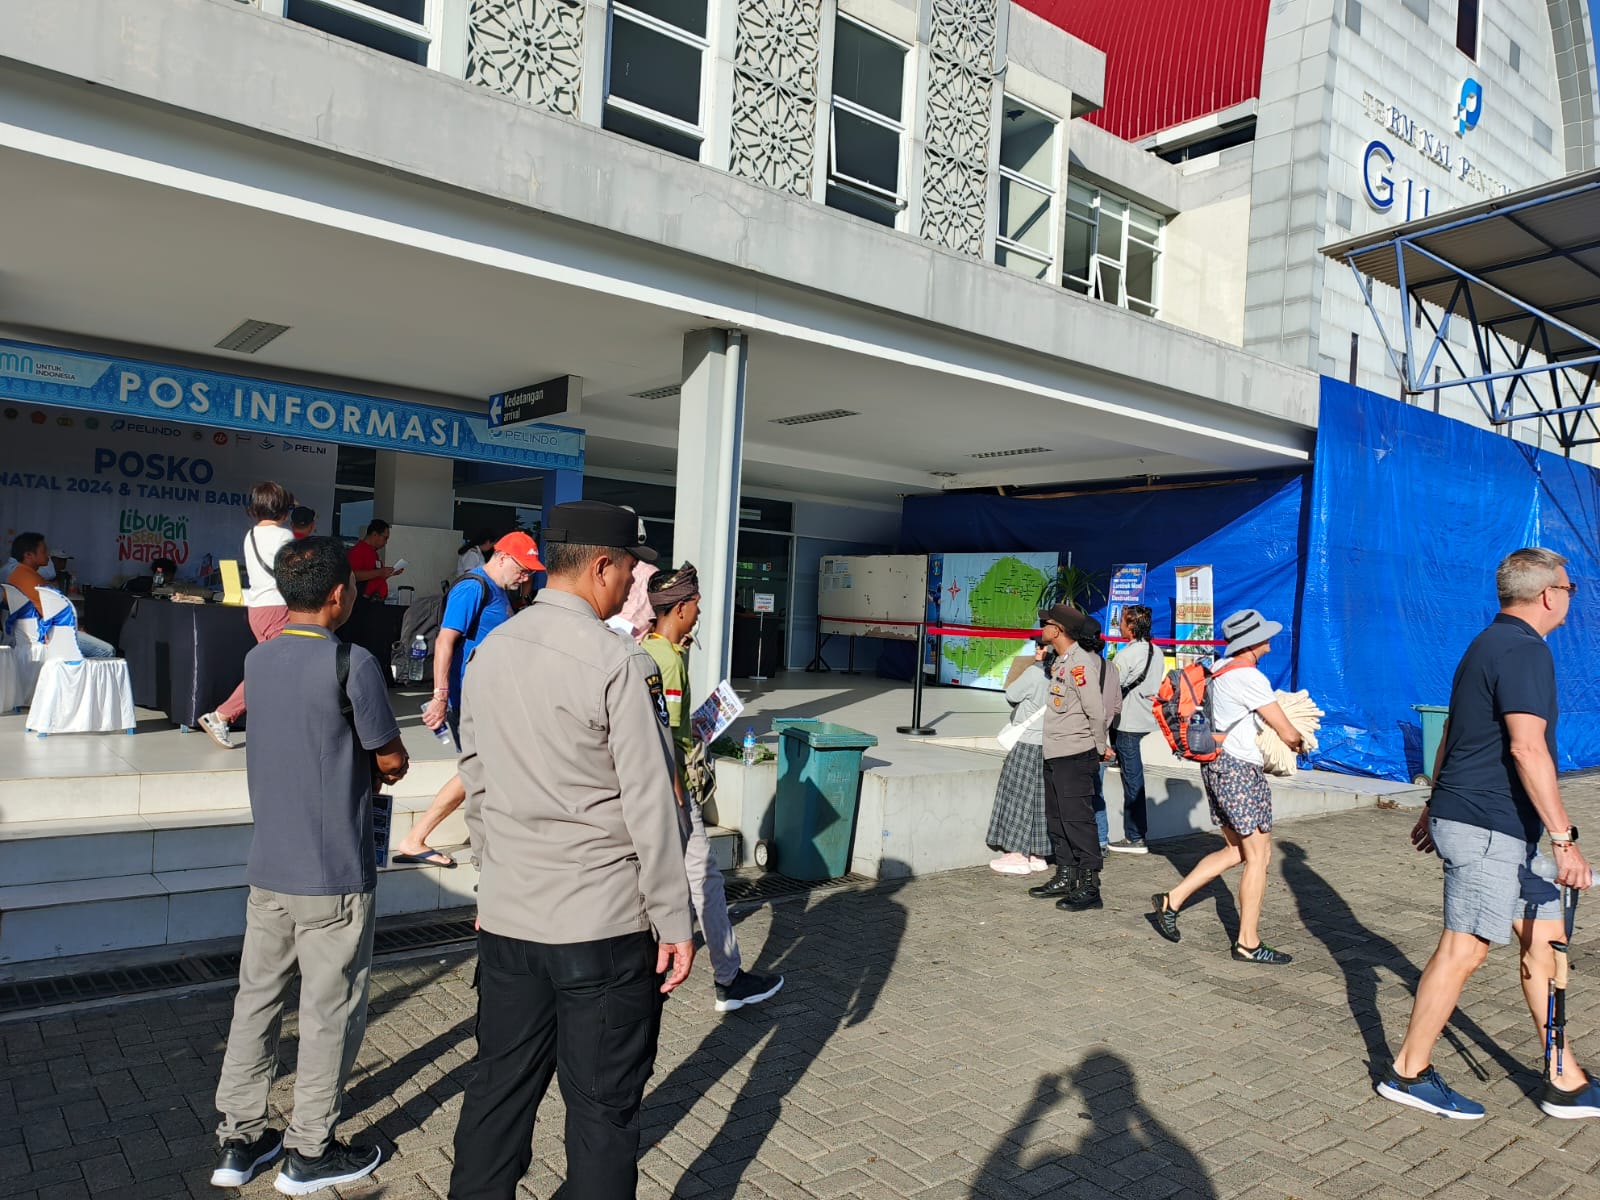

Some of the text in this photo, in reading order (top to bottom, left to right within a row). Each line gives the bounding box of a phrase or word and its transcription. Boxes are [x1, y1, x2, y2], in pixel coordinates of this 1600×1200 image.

[36, 363, 62, 372] UNTUK
[36, 370, 75, 380] INDONESIA
[504, 389, 544, 408] Kedatangan
[119, 371, 460, 447] POS INFORMASI
[503, 407, 520, 422] arrival
[127, 423, 182, 437] PELINDO
[505, 430, 558, 446] PELINDO
[295, 444, 327, 455] PELNI
[94, 448, 214, 485] POSKO
[0, 472, 252, 507] NATAL 2024 & TAHUN BARU
[119, 509, 188, 540] Liburan
